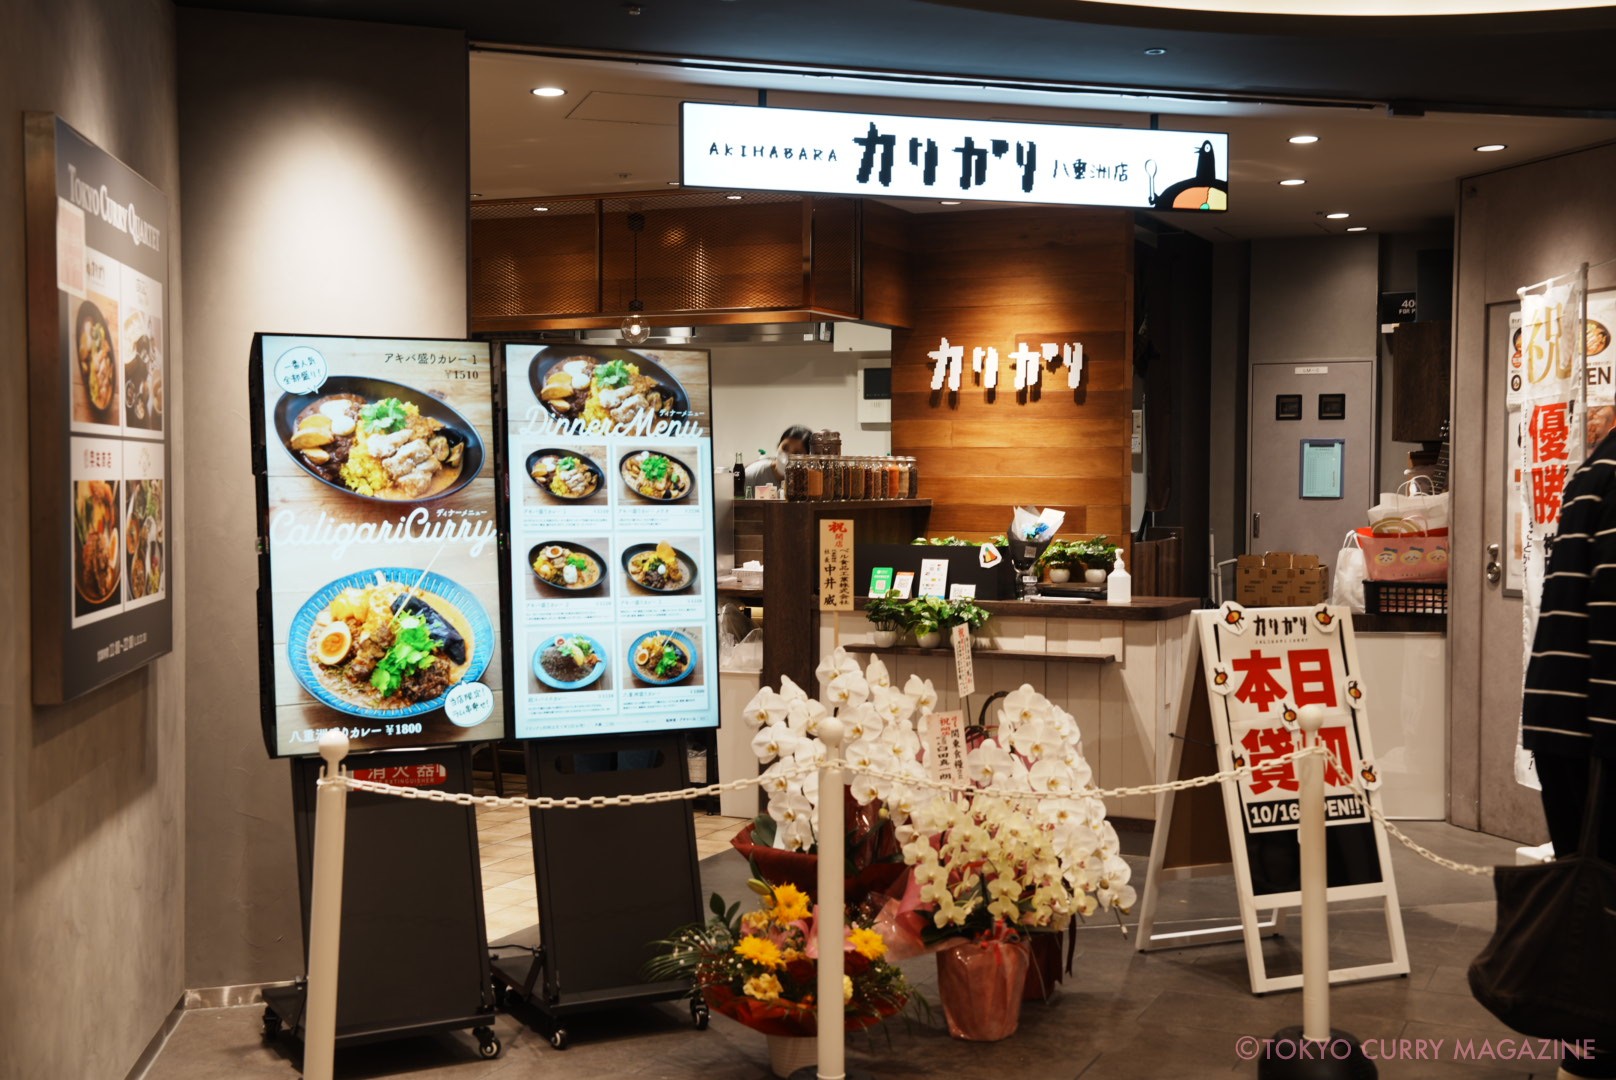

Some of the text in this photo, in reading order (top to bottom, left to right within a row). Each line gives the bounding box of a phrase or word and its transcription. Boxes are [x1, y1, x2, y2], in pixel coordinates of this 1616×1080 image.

[709, 121, 1129, 193] AKIHABARA カリガリ 八重洲店
[68, 163, 100, 216] TOKYO
[100, 184, 128, 233] CURRY
[384, 352, 467, 365] アキバ盛りカレー
[927, 336, 1083, 391] カリガリ
[1528, 401, 1569, 525] 優勝
[1253, 614, 1307, 637] カリガリ
[1231, 648, 1338, 712] 本日
[289, 723, 422, 744] 八重洲りカレー ¥1800
[1251, 797, 1361, 824] 10/16 EN!!
